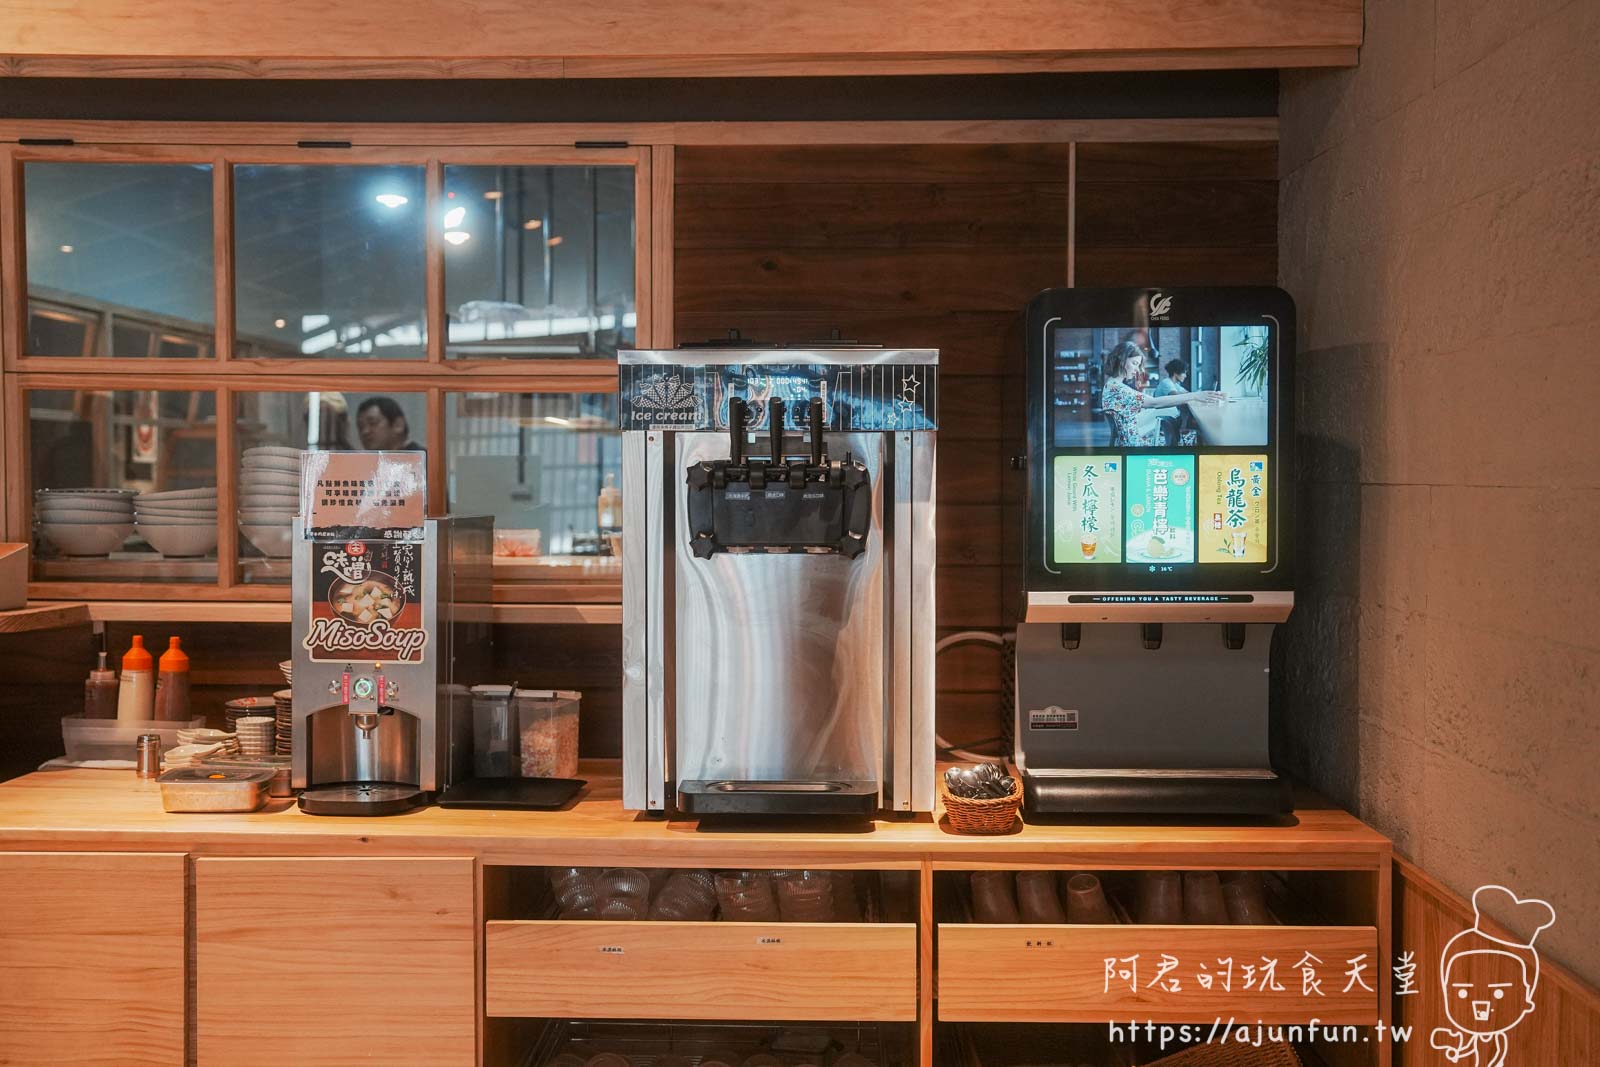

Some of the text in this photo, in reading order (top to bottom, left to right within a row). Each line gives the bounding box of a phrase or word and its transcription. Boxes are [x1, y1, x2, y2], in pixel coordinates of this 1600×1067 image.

[631, 410, 702, 421] Ice cream
[1081, 464, 1099, 533] 冬瓜檸檬
[1152, 468, 1168, 536] 芭樂青檸
[1225, 468, 1247, 528] 烏龍茶
